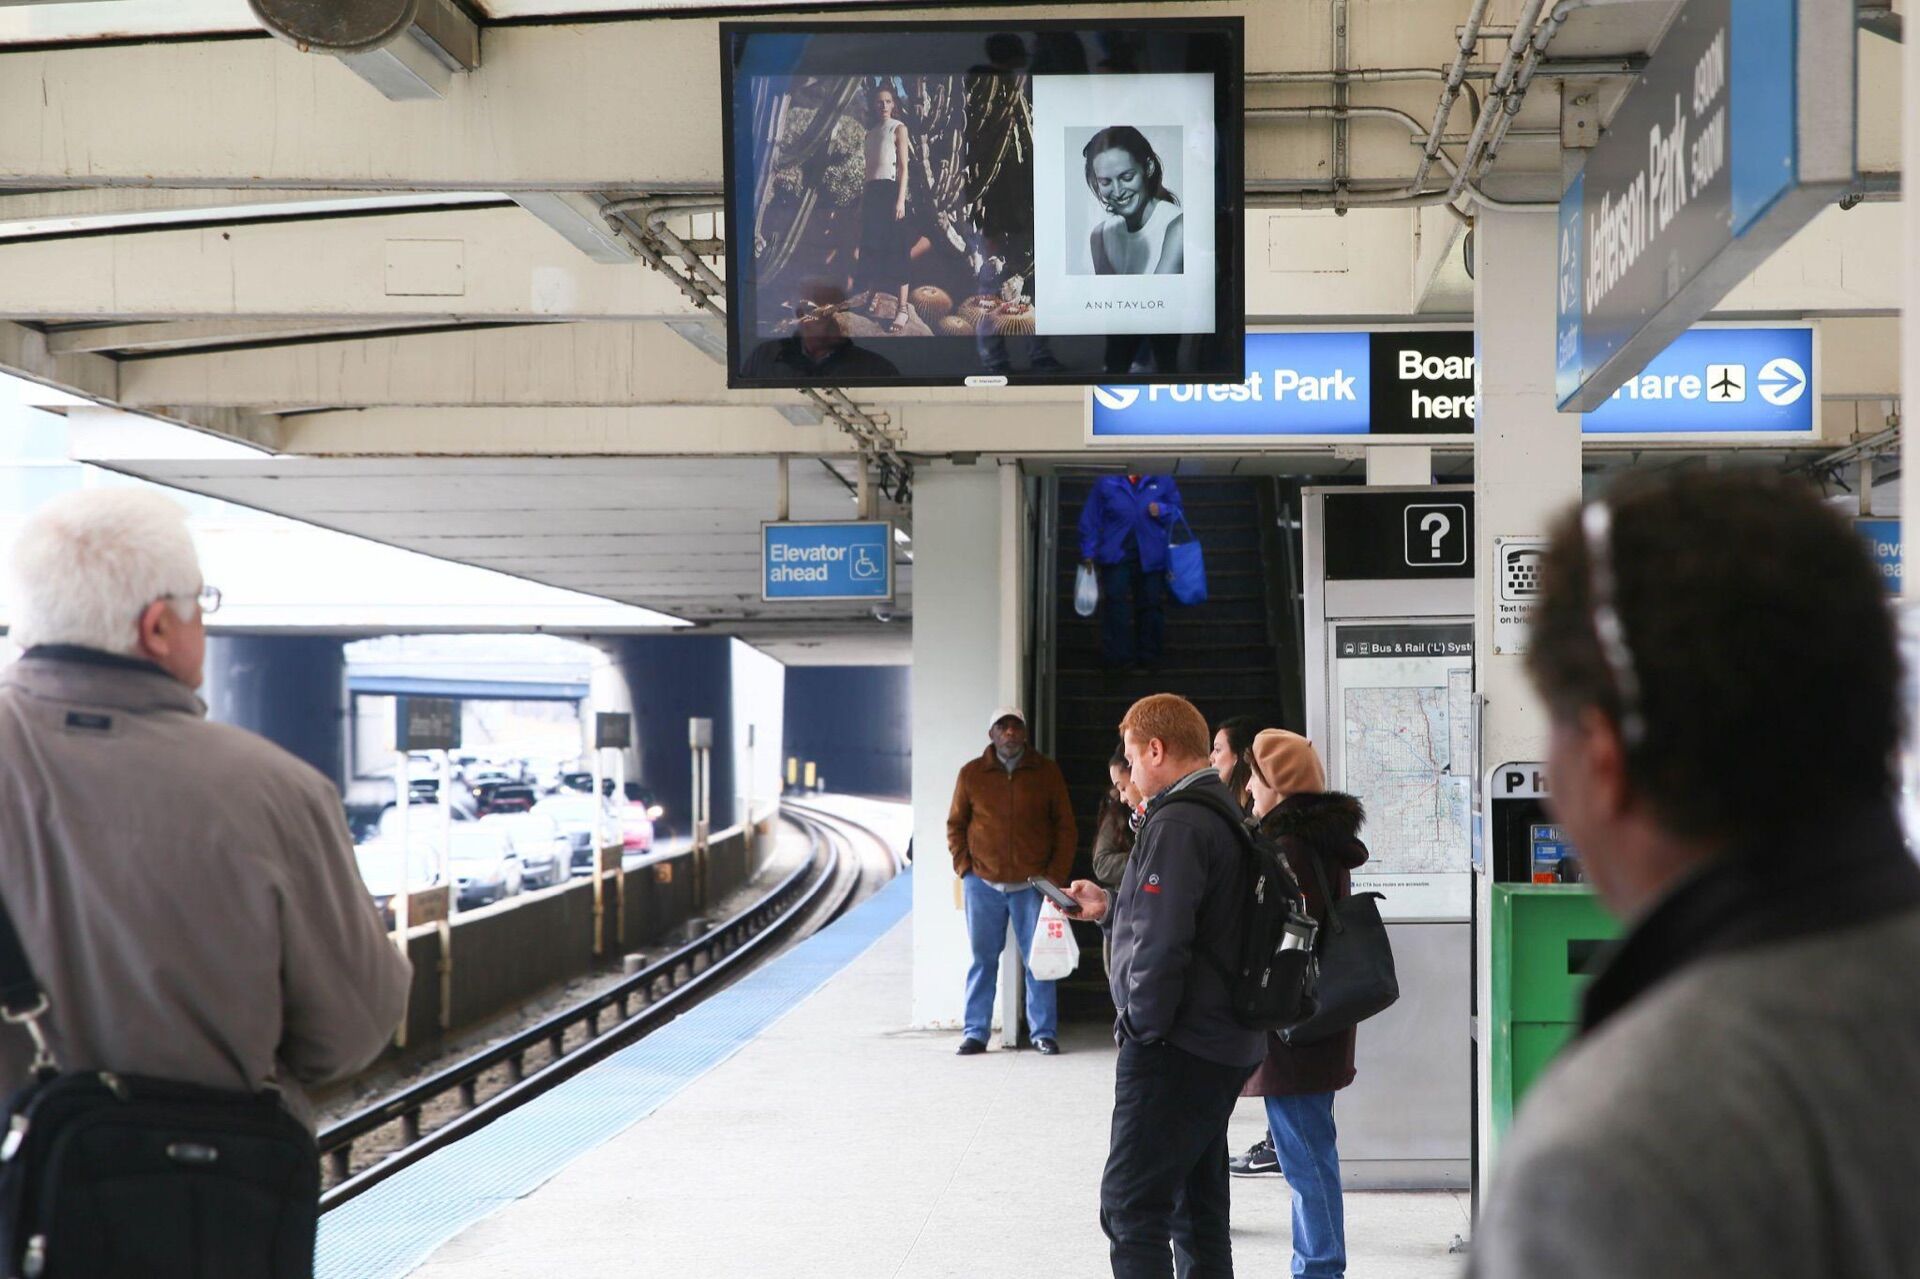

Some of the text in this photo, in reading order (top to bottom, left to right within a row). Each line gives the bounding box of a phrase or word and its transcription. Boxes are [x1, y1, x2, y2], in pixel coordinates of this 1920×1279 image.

[1586, 93, 1687, 314] Jefferson Park
[1085, 300, 1165, 310] ANN TAYLOR
[1398, 350, 1476, 380] Boar
[1274, 368, 1356, 402] Park
[1411, 389, 1475, 419] here
[769, 543, 847, 562] Elevator
[769, 563, 829, 582] ahead
[1499, 604, 1517, 612] Text
[1371, 643, 1392, 653] Bus
[1394, 643, 1403, 653] &
[1405, 642, 1425, 653] Rail
